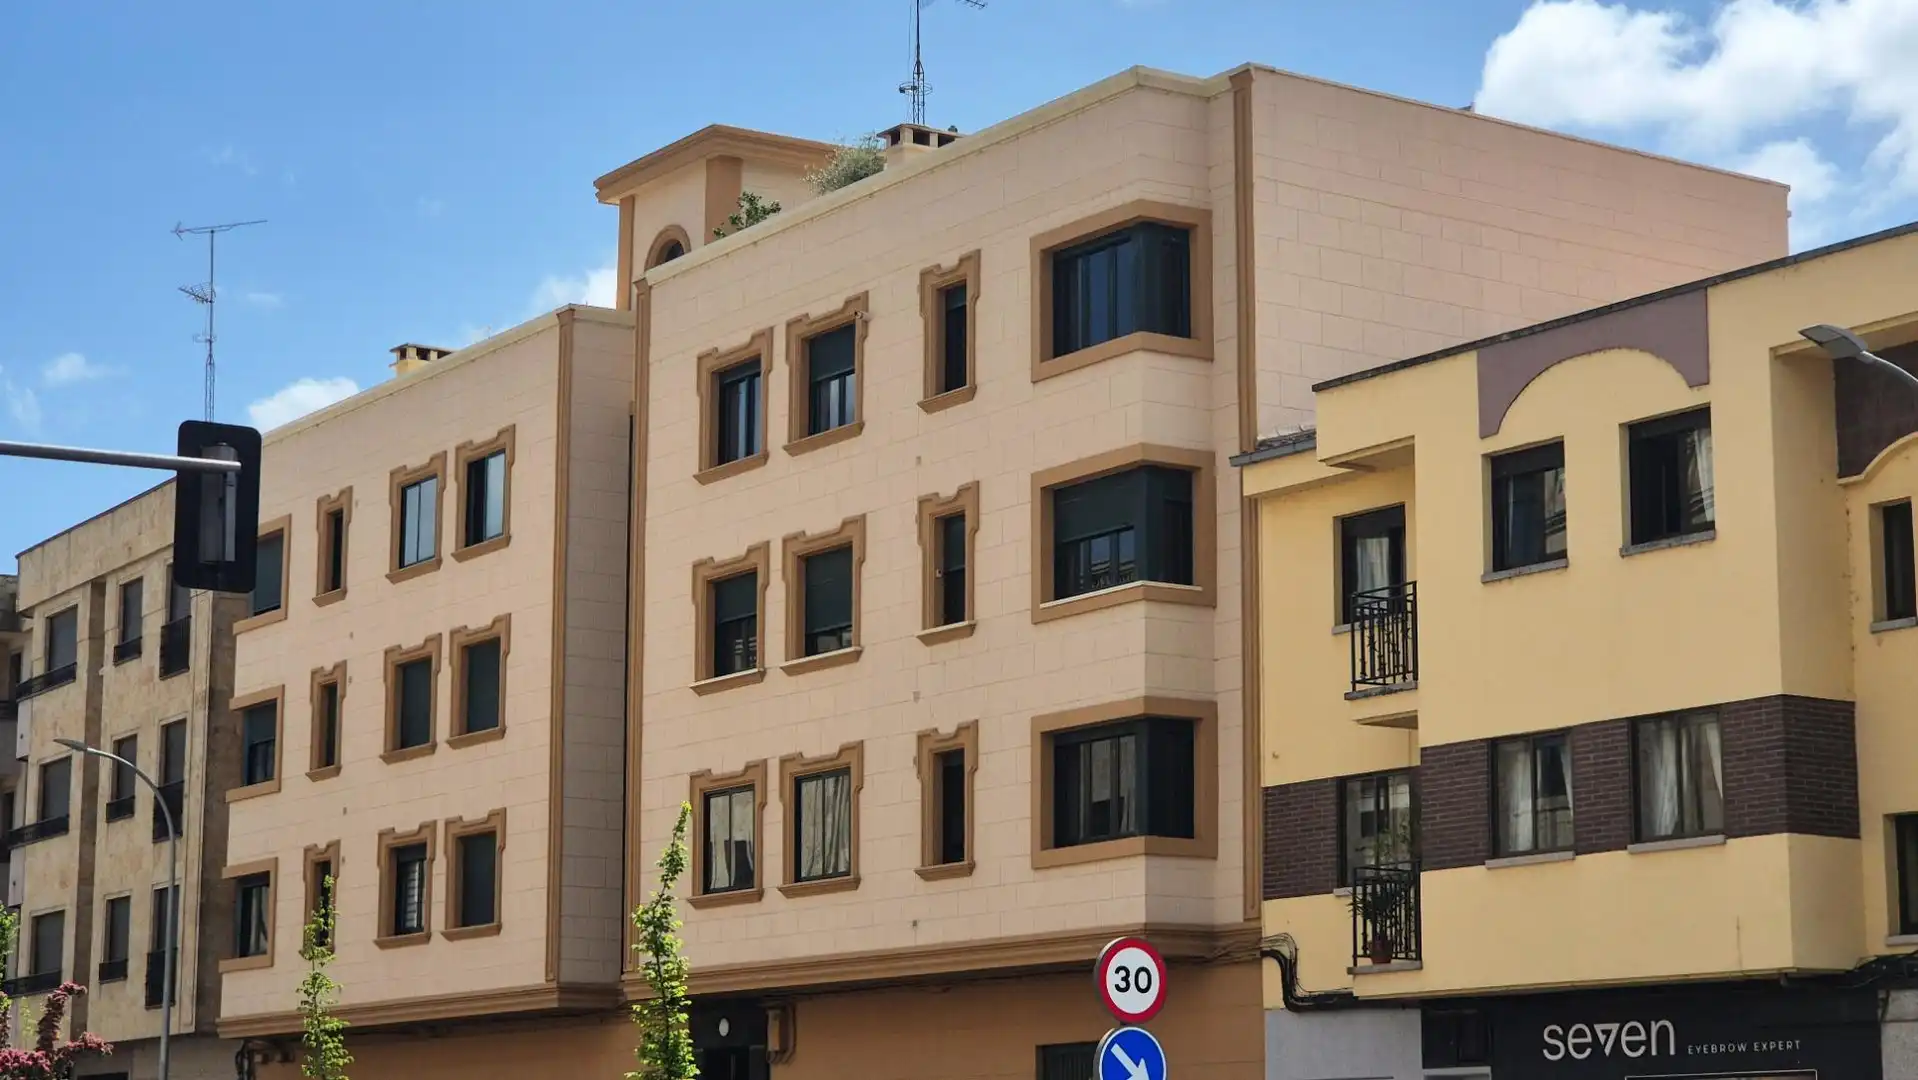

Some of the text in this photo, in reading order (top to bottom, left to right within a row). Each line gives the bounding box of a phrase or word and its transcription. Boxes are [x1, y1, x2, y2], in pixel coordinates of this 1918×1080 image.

[1114, 965, 1152, 994] 30
[1543, 1019, 1676, 1061] seven
[1687, 1040, 1800, 1055] EYEBROW EXPERT
